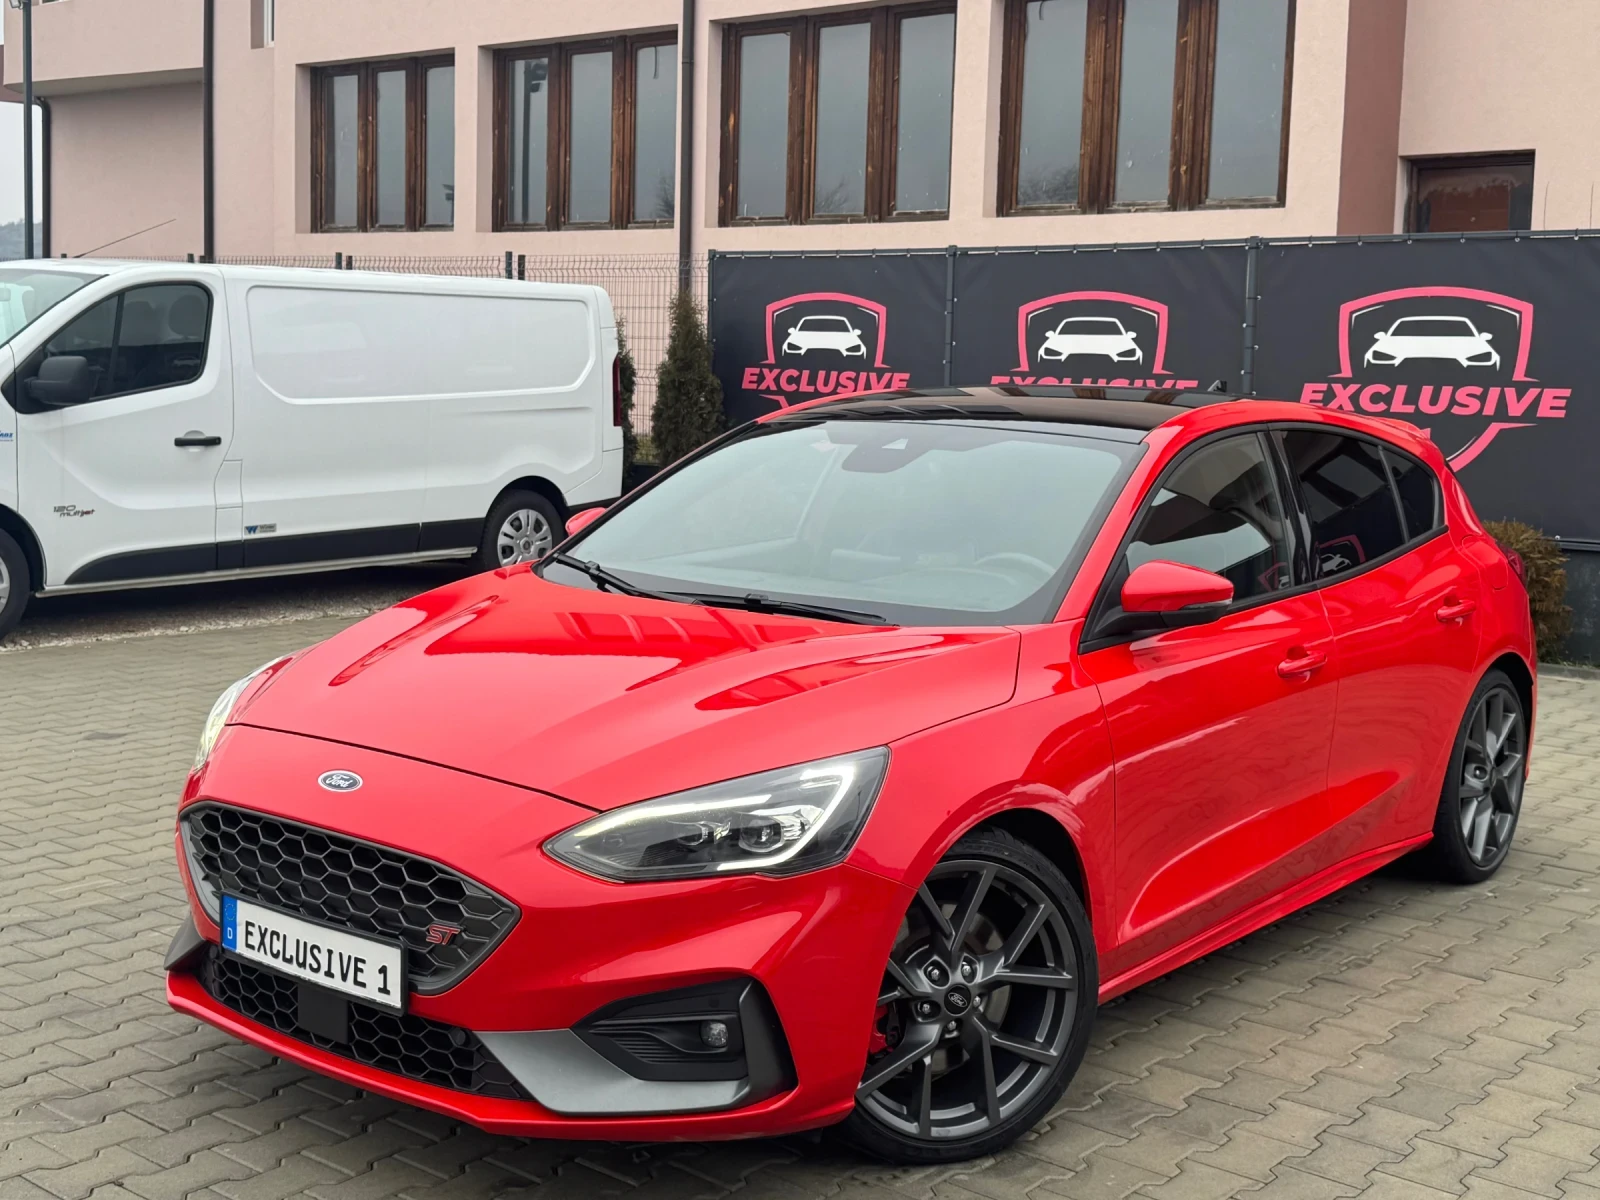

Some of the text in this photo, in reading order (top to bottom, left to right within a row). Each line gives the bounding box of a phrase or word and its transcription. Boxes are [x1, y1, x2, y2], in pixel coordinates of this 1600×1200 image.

[742, 367, 911, 394] EXCLUSIVE
[1299, 383, 1572, 418] EXCLUSIVE
[325, 773, 354, 788] Ford
[227, 927, 233, 940] D
[425, 923, 461, 945] ST
[244, 920, 391, 996] EXCLUSIVE 1
[950, 993, 966, 1007] Ford
